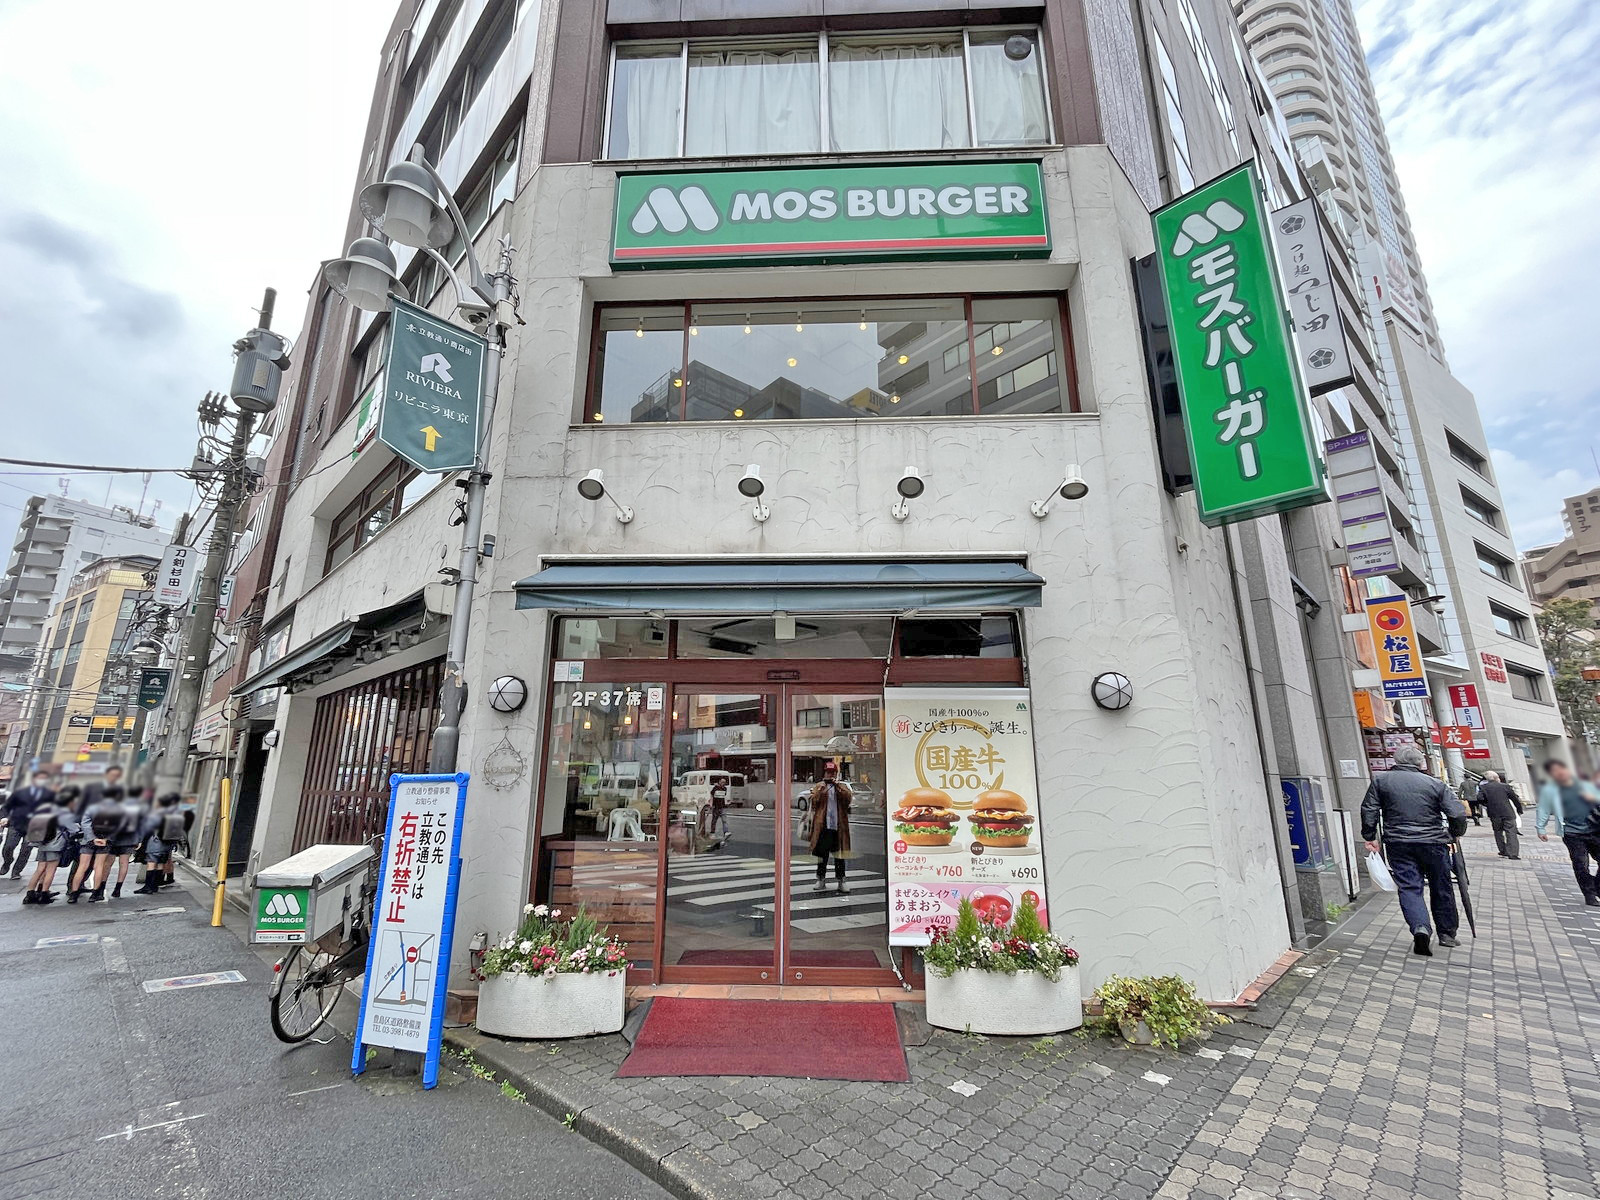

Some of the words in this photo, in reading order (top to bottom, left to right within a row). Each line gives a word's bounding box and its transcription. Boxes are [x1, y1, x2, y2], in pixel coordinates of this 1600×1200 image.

[730, 189, 837, 221] MOS
[847, 185, 1030, 218] BURGER
[419, 328, 472, 356] 立教通り商店街
[1191, 244, 1264, 479] モスバーガー
[405, 370, 463, 400] RIVIERA
[394, 390, 470, 424] リビエラ東京
[1327, 435, 1367, 450] SP-1ビル
[168, 549, 187, 587] 刀剣杉田
[1383, 634, 1414, 673] 松屋
[928, 708, 990, 717] 国産牛100%の
[925, 743, 1006, 775] 国産牛
[938, 773, 991, 790] 100%
[405, 786, 451, 796] 立教通り整備事業
[415, 797, 438, 806] お知らせ
[431, 812, 447, 865] この先
[411, 811, 434, 900] 立教通りは
[894, 856, 927, 864] 新とびきり
[970, 857, 1004, 865] 新とびきり
[386, 811, 419, 924] 右折禁止
[936, 865, 963, 877] ¥760
[1011, 867, 1038, 879] ¥690
[894, 888, 950, 898] まぜるシェイク
[895, 899, 941, 912] あまおう
[901, 915, 922, 923] ¥340
[930, 915, 952, 924] ¥420
[372, 1025, 382, 1033] TEL
[373, 1014, 422, 1030] 豊島区道路整備課
